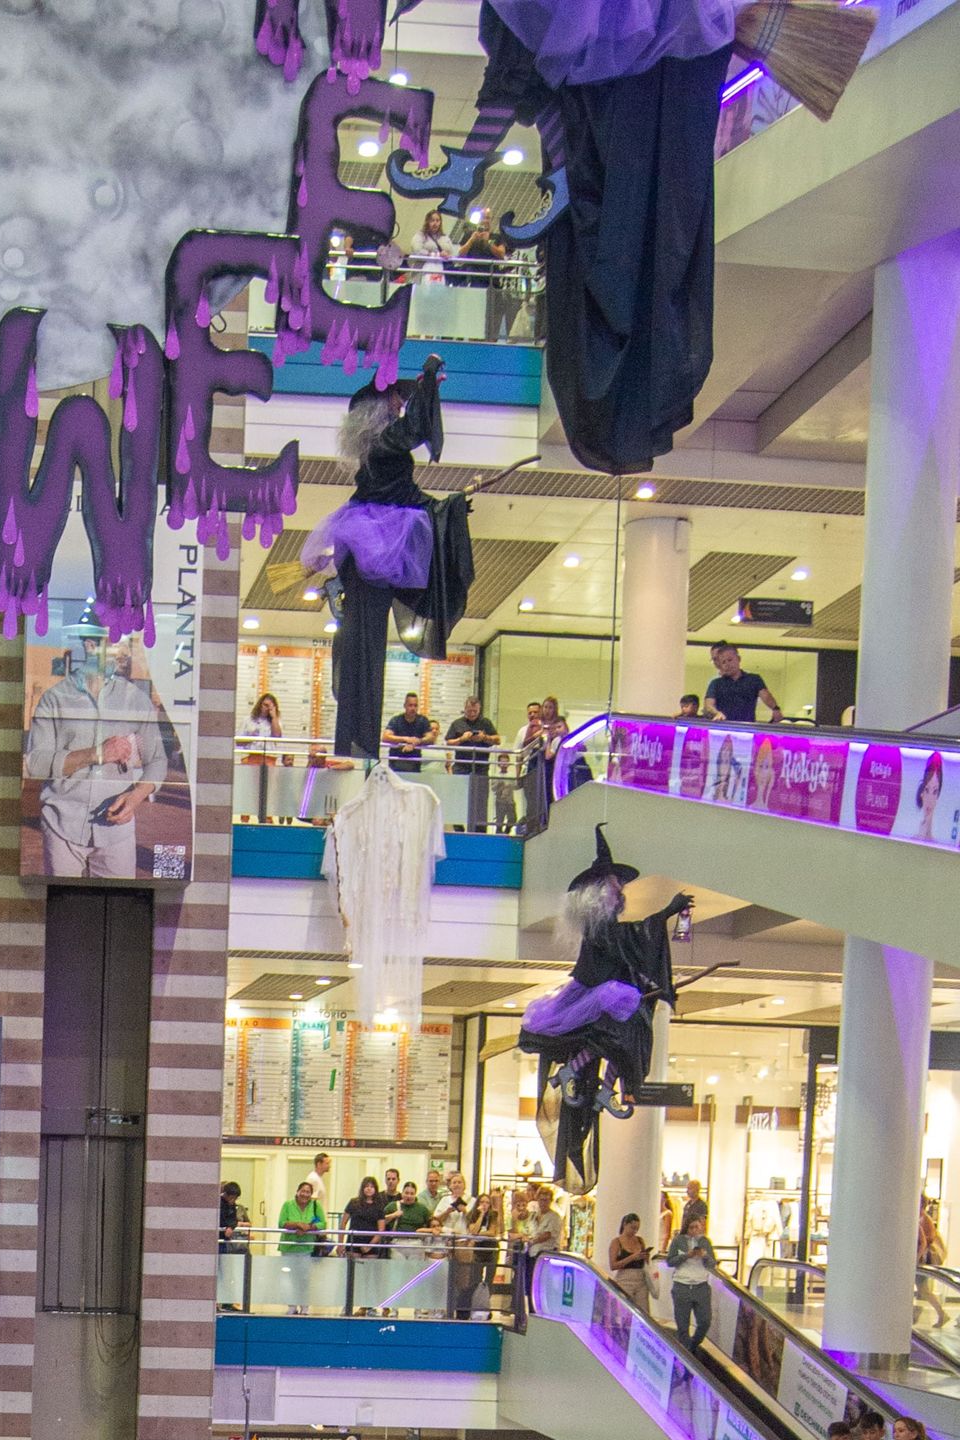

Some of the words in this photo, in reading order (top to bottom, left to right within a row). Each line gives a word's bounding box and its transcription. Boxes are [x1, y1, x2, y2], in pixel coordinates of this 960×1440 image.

[174, 543, 198, 680] PLANTA
[780, 750, 830, 793] Ricky's
[281, 1137, 341, 1147] ASCENSORES
